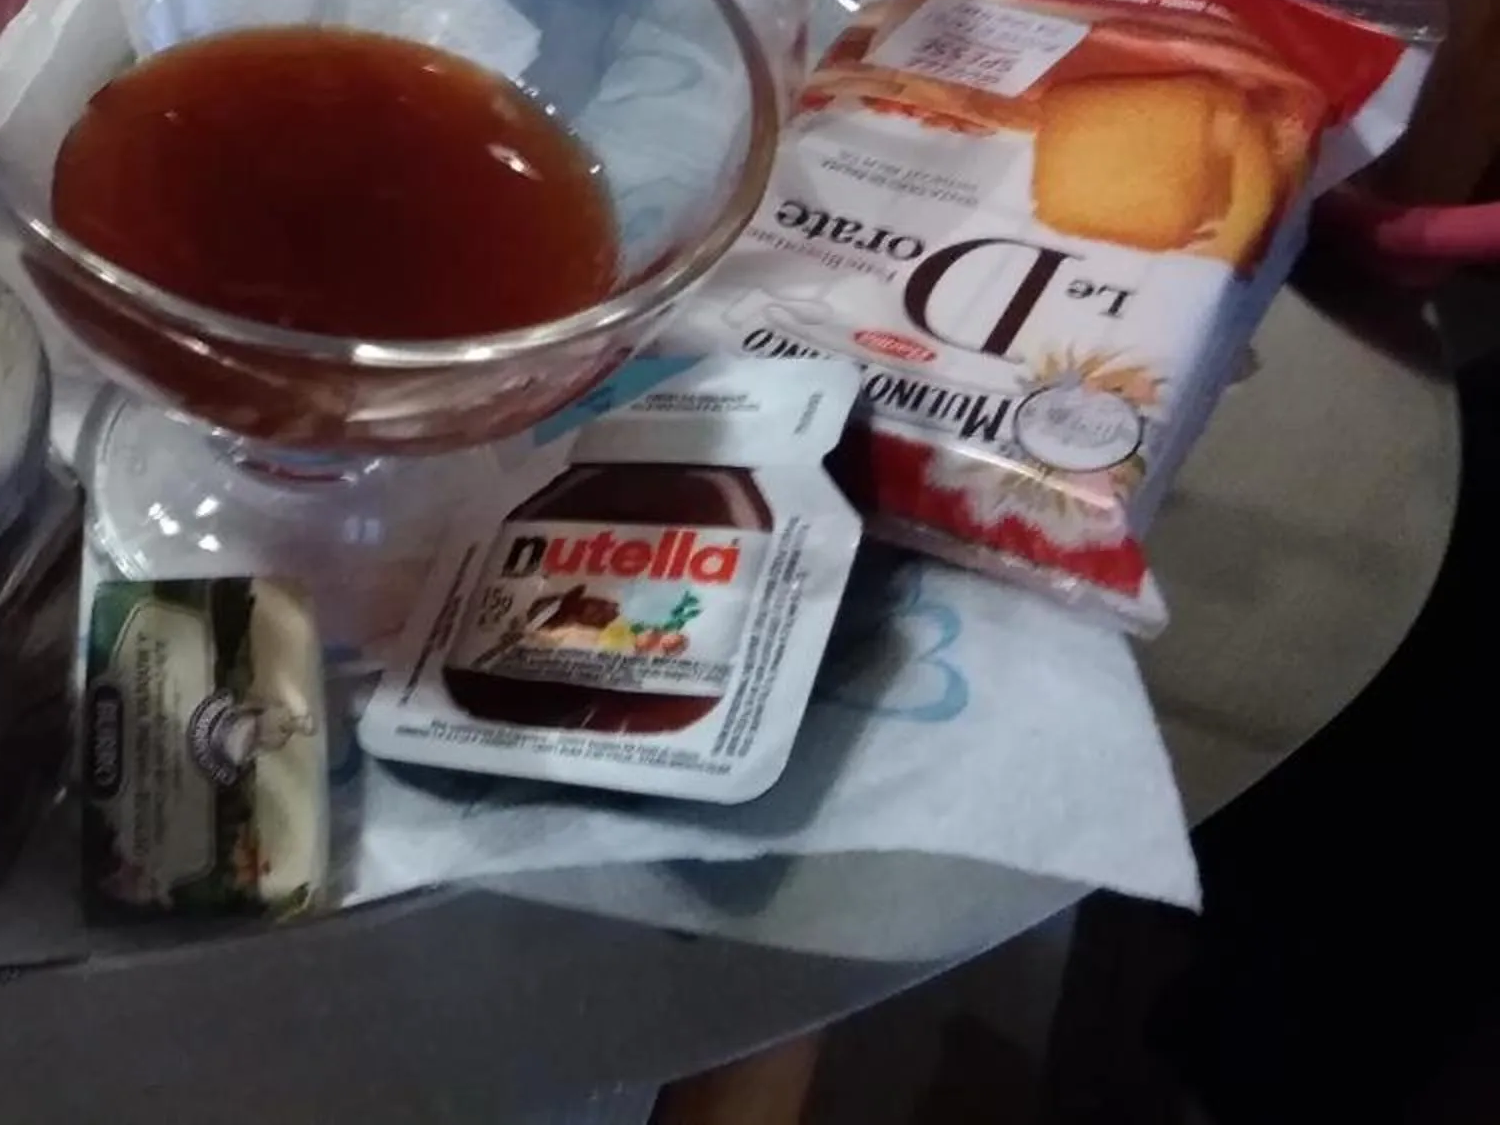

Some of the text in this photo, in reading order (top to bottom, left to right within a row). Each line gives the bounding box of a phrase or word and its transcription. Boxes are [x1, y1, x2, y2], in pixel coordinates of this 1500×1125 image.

[1066, 275, 1140, 321] Le
[864, 372, 1014, 443] MULINO
[502, 530, 740, 584] nutella
[94, 702, 119, 787] BURRO
